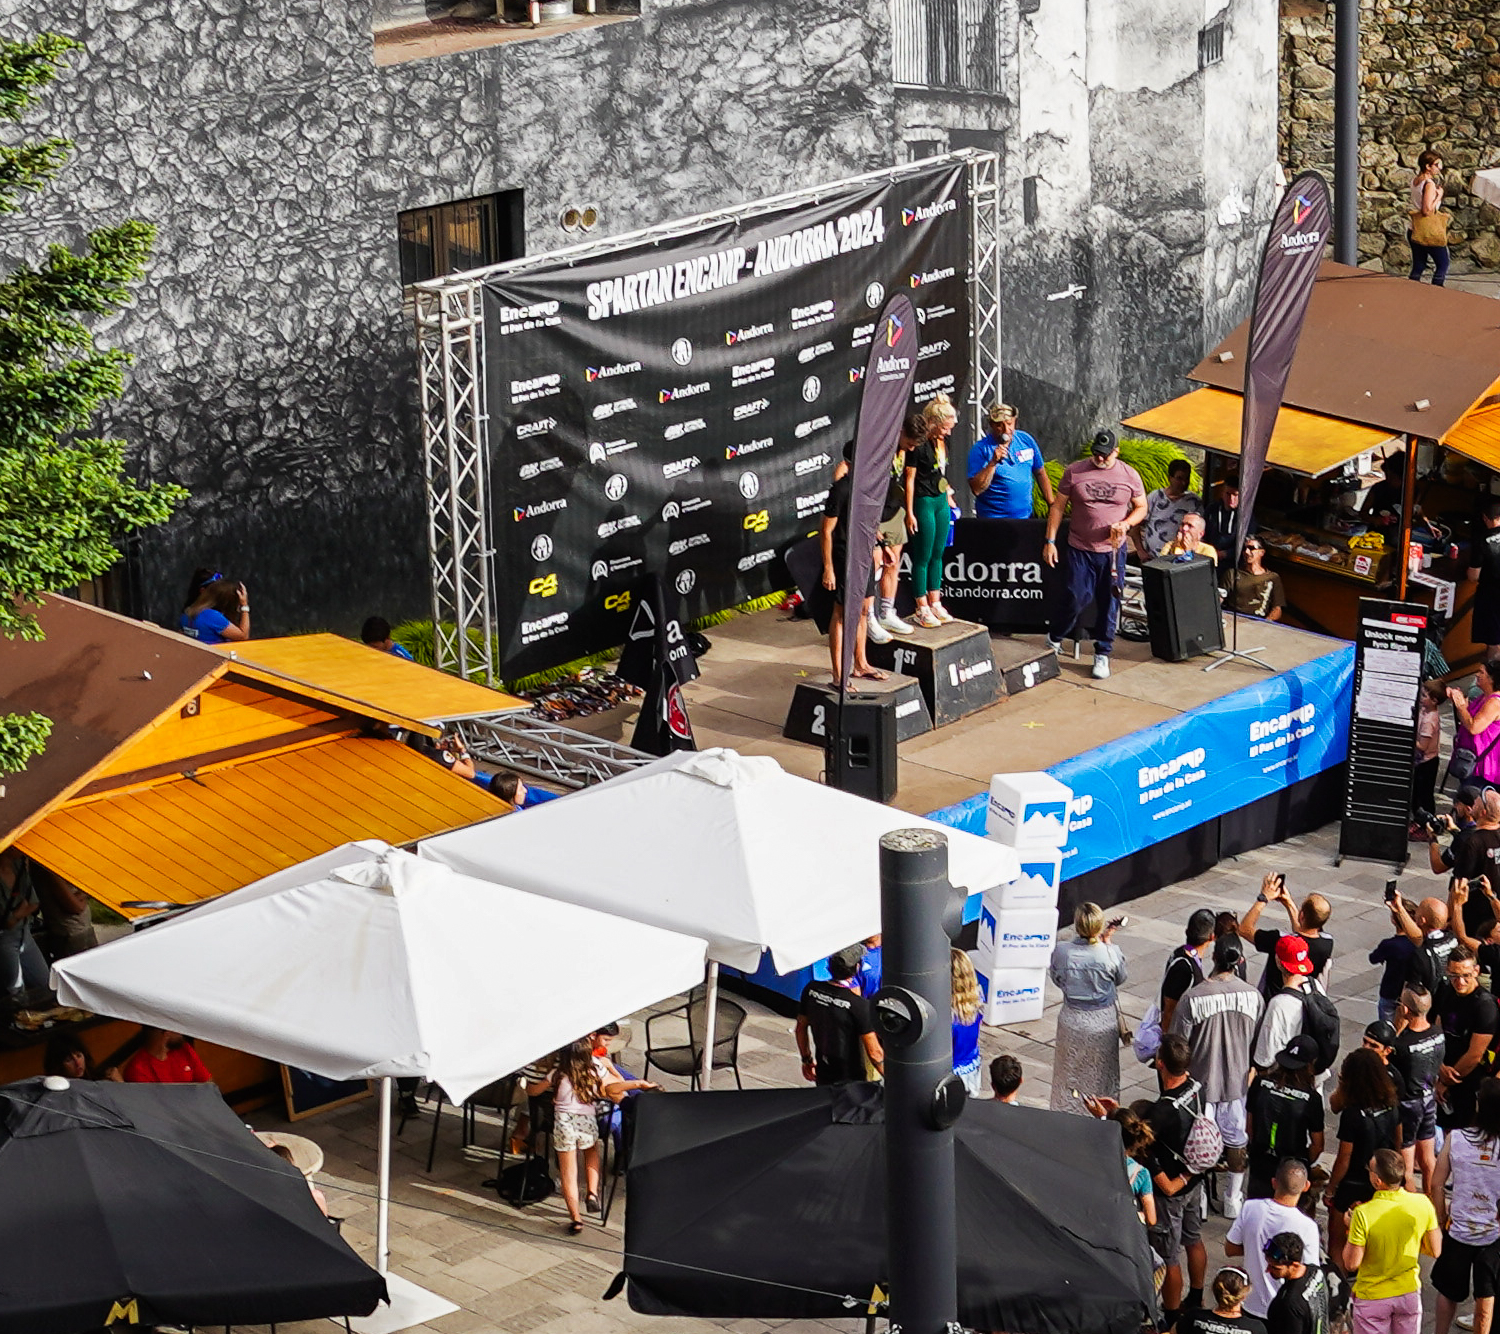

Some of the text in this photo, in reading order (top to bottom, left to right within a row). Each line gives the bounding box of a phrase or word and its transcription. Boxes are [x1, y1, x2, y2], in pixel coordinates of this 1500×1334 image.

[914, 199, 956, 221] Andorra
[586, 264, 673, 321] SPARTAN
[675, 247, 746, 300] ENCAMP
[754, 221, 839, 277] ANDORRA
[838, 206, 885, 253] 2024
[921, 268, 955, 285] Andorra
[500, 300, 560, 323] Encamp
[791, 300, 835, 321] Encamp
[736, 323, 774, 343] Andorra
[598, 361, 642, 379] Andorra
[732, 358, 775, 379] Encamp
[511, 374, 560, 395] Encamp
[671, 382, 710, 400] Andorra
[914, 374, 955, 395] Encamp
[736, 437, 774, 456] Andorra
[525, 498, 568, 518] Andorra
[940, 588, 1044, 600] sitandorra.com
[521, 612, 569, 635] Encamp
[1250, 702, 1316, 742] Encamp
[1138, 747, 1206, 789] Encamp
[1002, 932, 1050, 942] Encamp
[996, 985, 1040, 999] Encamp
[104, 1298, 140, 1326] M
